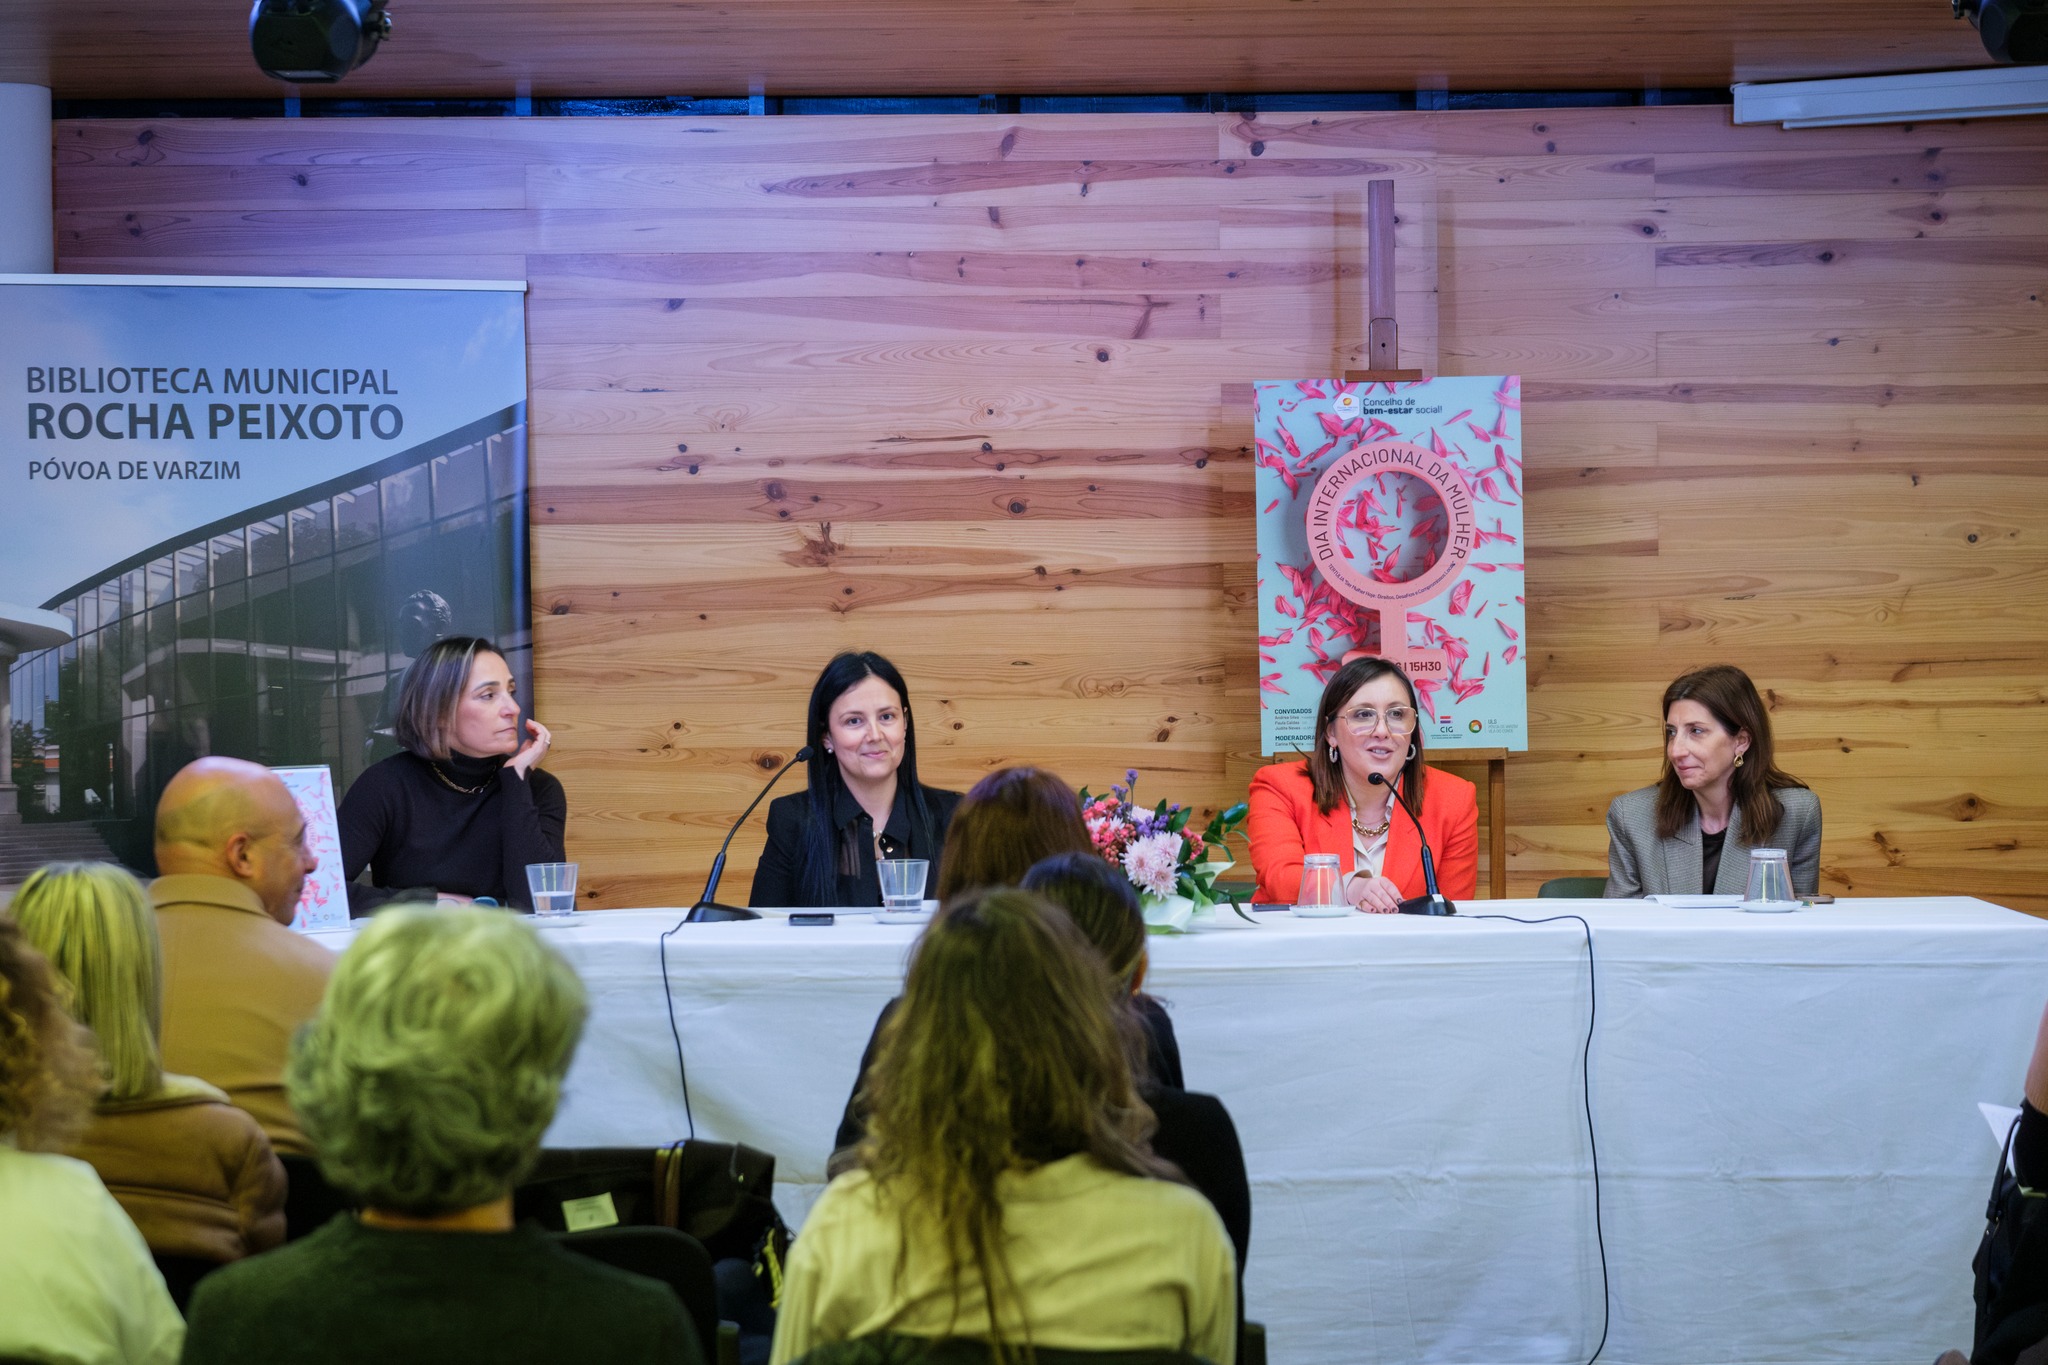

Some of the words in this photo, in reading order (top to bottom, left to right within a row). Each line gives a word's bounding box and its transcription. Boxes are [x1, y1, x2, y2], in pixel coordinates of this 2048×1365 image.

[27, 366, 213, 394] BIBLIOTECA
[223, 368, 399, 395] MUNICIPAL
[1363, 397, 1403, 406] Concelho
[1405, 397, 1416, 406] de
[1363, 406, 1413, 415] bem-estar
[1415, 405, 1443, 414] social!
[27, 402, 195, 440] ROCHA
[208, 403, 404, 440] PEIXOTO
[28, 456, 112, 480] PÓVOA
[118, 461, 148, 480] DE
[152, 461, 241, 480] VARZIM
[1427, 462, 1450, 486] DA
[1313, 448, 1424, 526] INTERNACIONAL
[1445, 483, 1471, 559] MULHER
[1314, 531, 1334, 561] DIA
[1409, 661, 1441, 671] 15H30
